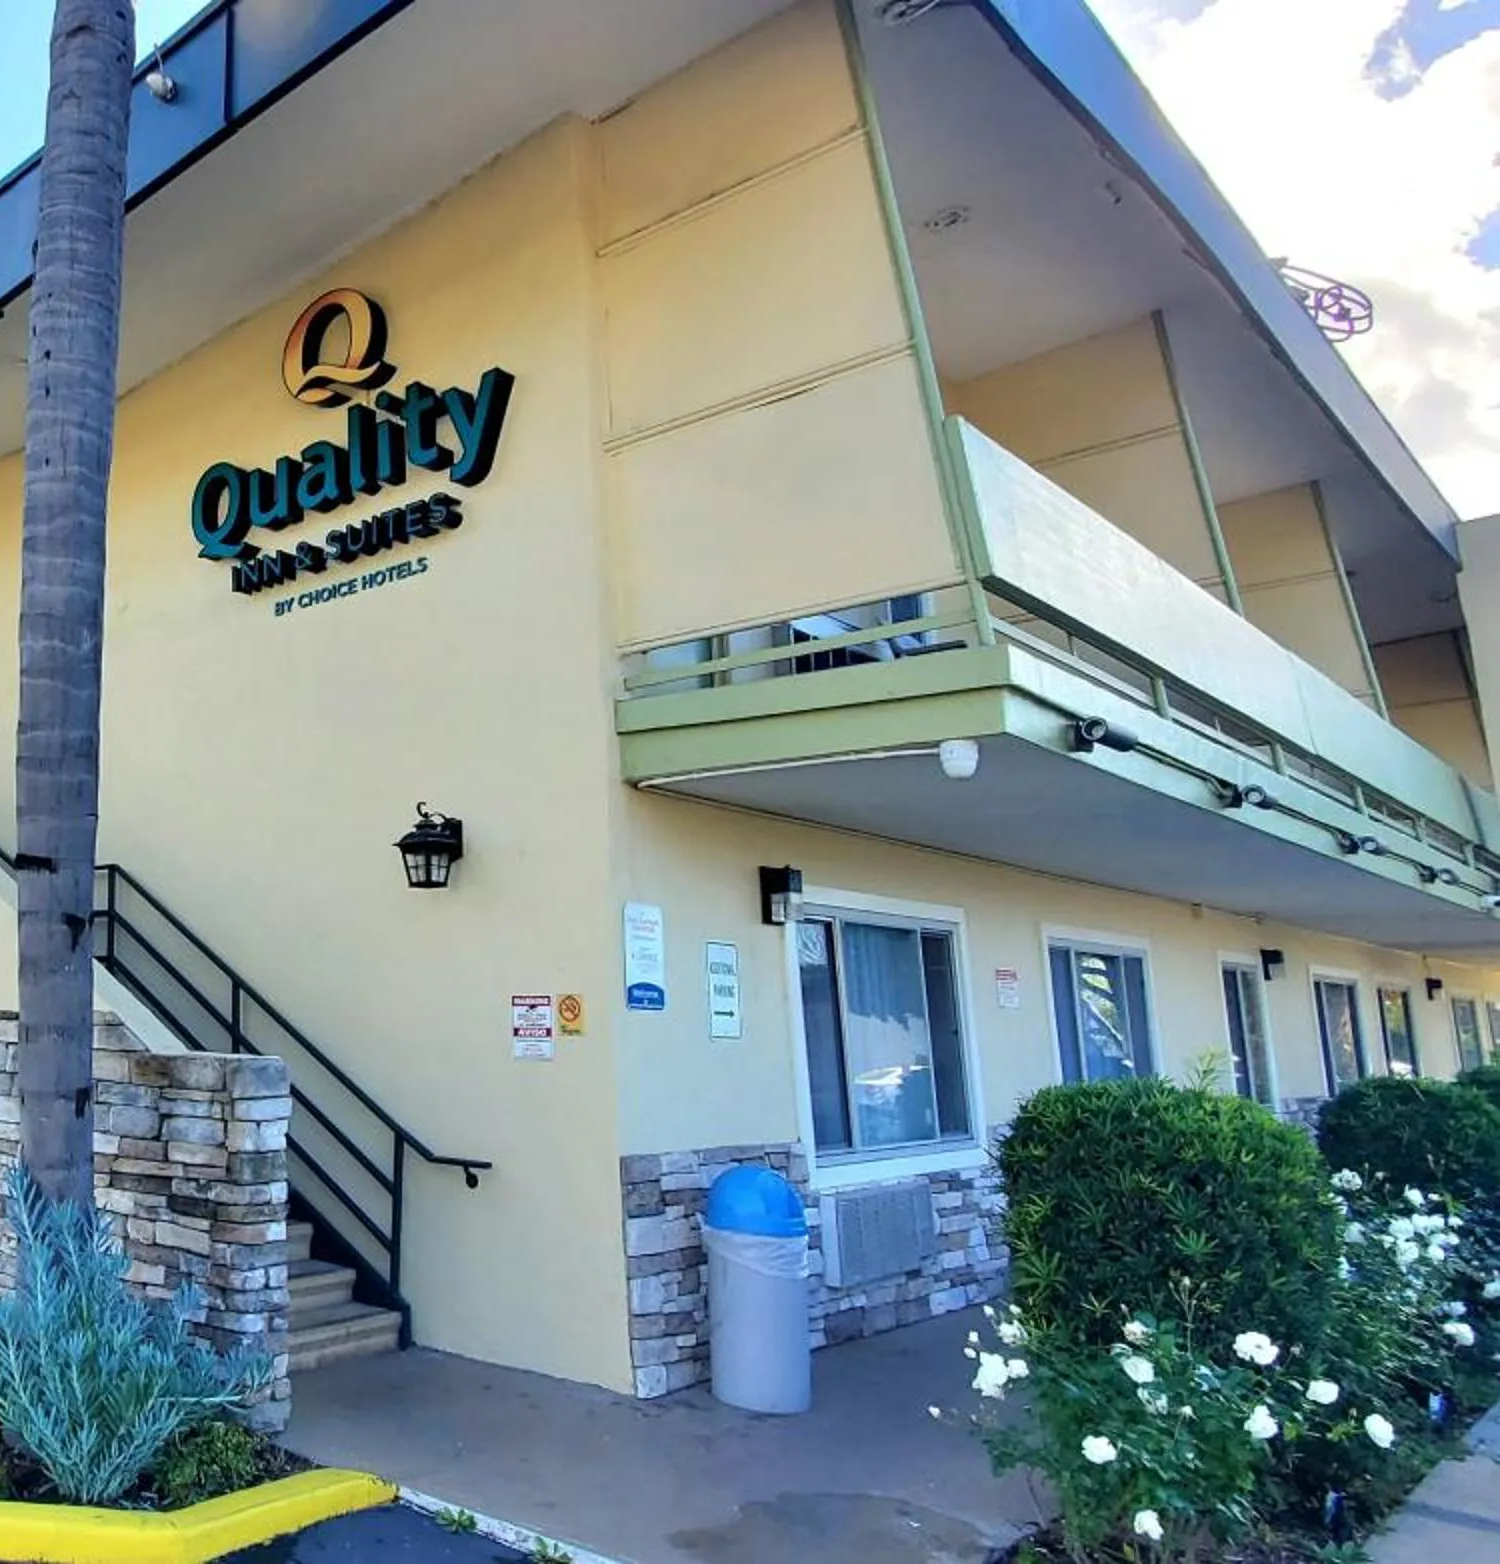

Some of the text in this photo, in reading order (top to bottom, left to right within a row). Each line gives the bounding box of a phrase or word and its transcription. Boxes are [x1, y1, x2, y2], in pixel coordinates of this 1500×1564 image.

[281, 287, 394, 407] Q
[191, 367, 515, 561] Quality
[232, 491, 463, 595] INN & SUITES
[274, 557, 429, 617] BY CHOICE HOTELS
